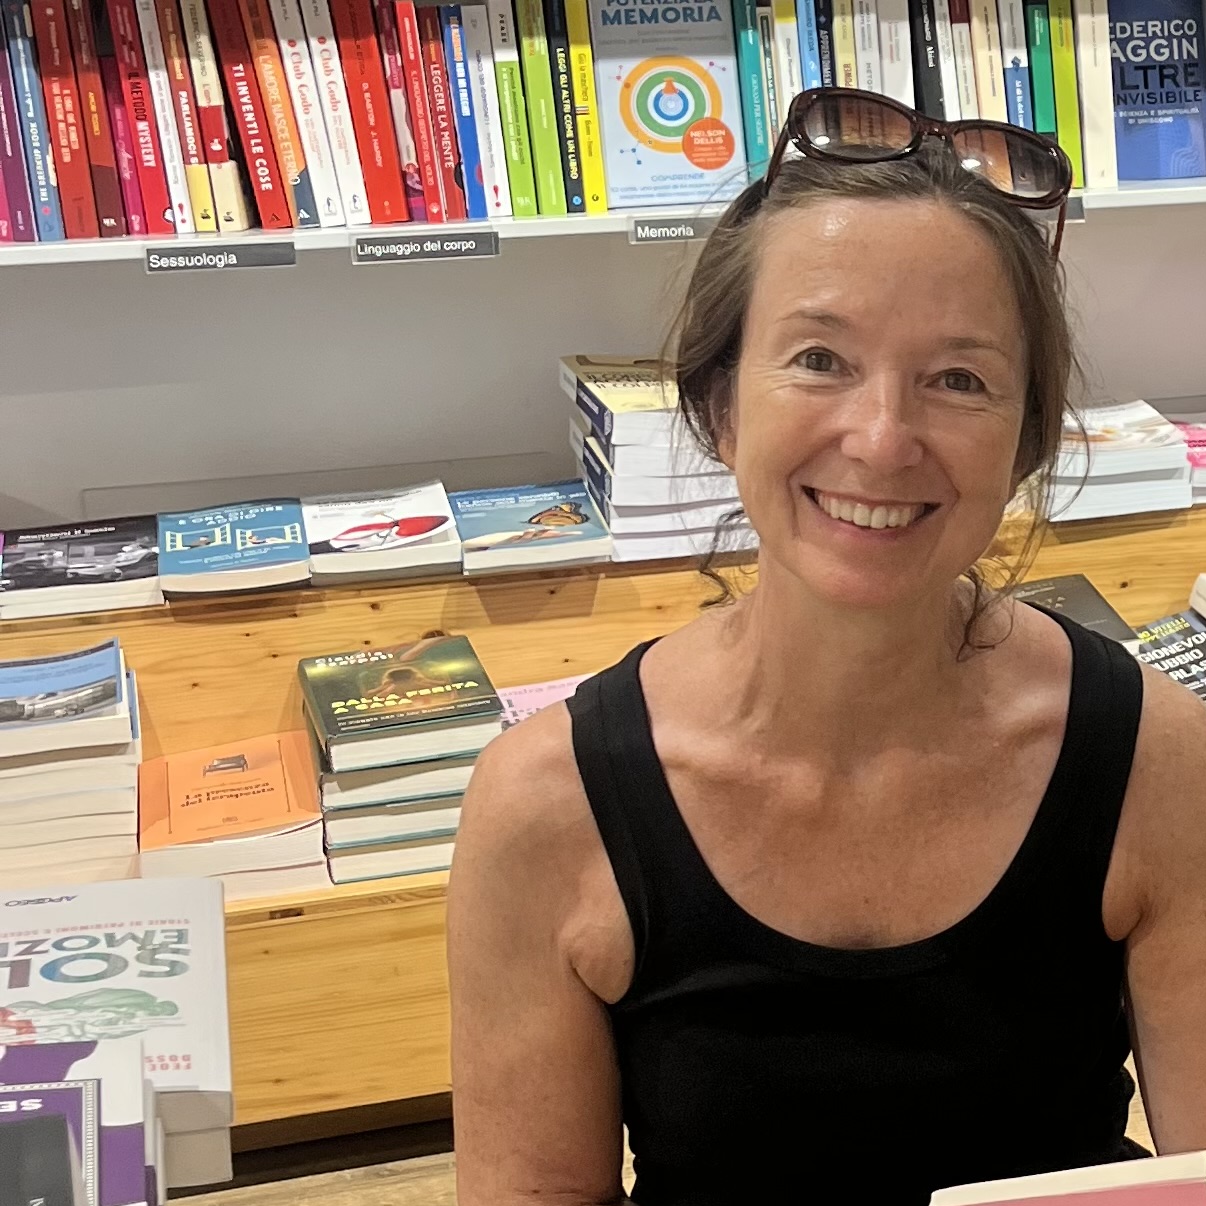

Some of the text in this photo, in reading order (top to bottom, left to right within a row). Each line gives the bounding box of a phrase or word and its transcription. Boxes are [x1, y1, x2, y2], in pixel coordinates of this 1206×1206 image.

[601, 6, 723, 26] MEMORIA
[1110, 37, 1198, 63] AGGIN
[287, 50, 316, 115] Club Godo
[316, 46, 345, 112] Club Godo
[1120, 63, 1201, 90] LTRE
[127, 80, 149, 122] METODO
[428, 62, 455, 169] LEGGERE LA MENTE
[555, 46, 579, 179] LEGGI GLI ALTRI COME UN LIBRO
[753, 103, 761, 117] PER
[176, 89, 199, 154] PARLIAMOCI
[231, 62, 273, 192] TI INVENTI LE COSE
[258, 53, 301, 186] L'AMORE NASCE ETERNO
[135, 119, 158, 168] MYSTERY
[694, 136, 724, 145] DELLIS
[29, 121, 48, 201] THE BREAKUP BOOK
[637, 224, 694, 238] Memoria
[149, 252, 238, 268] Sessuologia
[357, 240, 476, 256] Linguaggio del corpo
[1154, 648, 1204, 672] UBBIO
[331, 680, 480, 709] DALLA FERITA
[333, 698, 412, 714] A CASA
